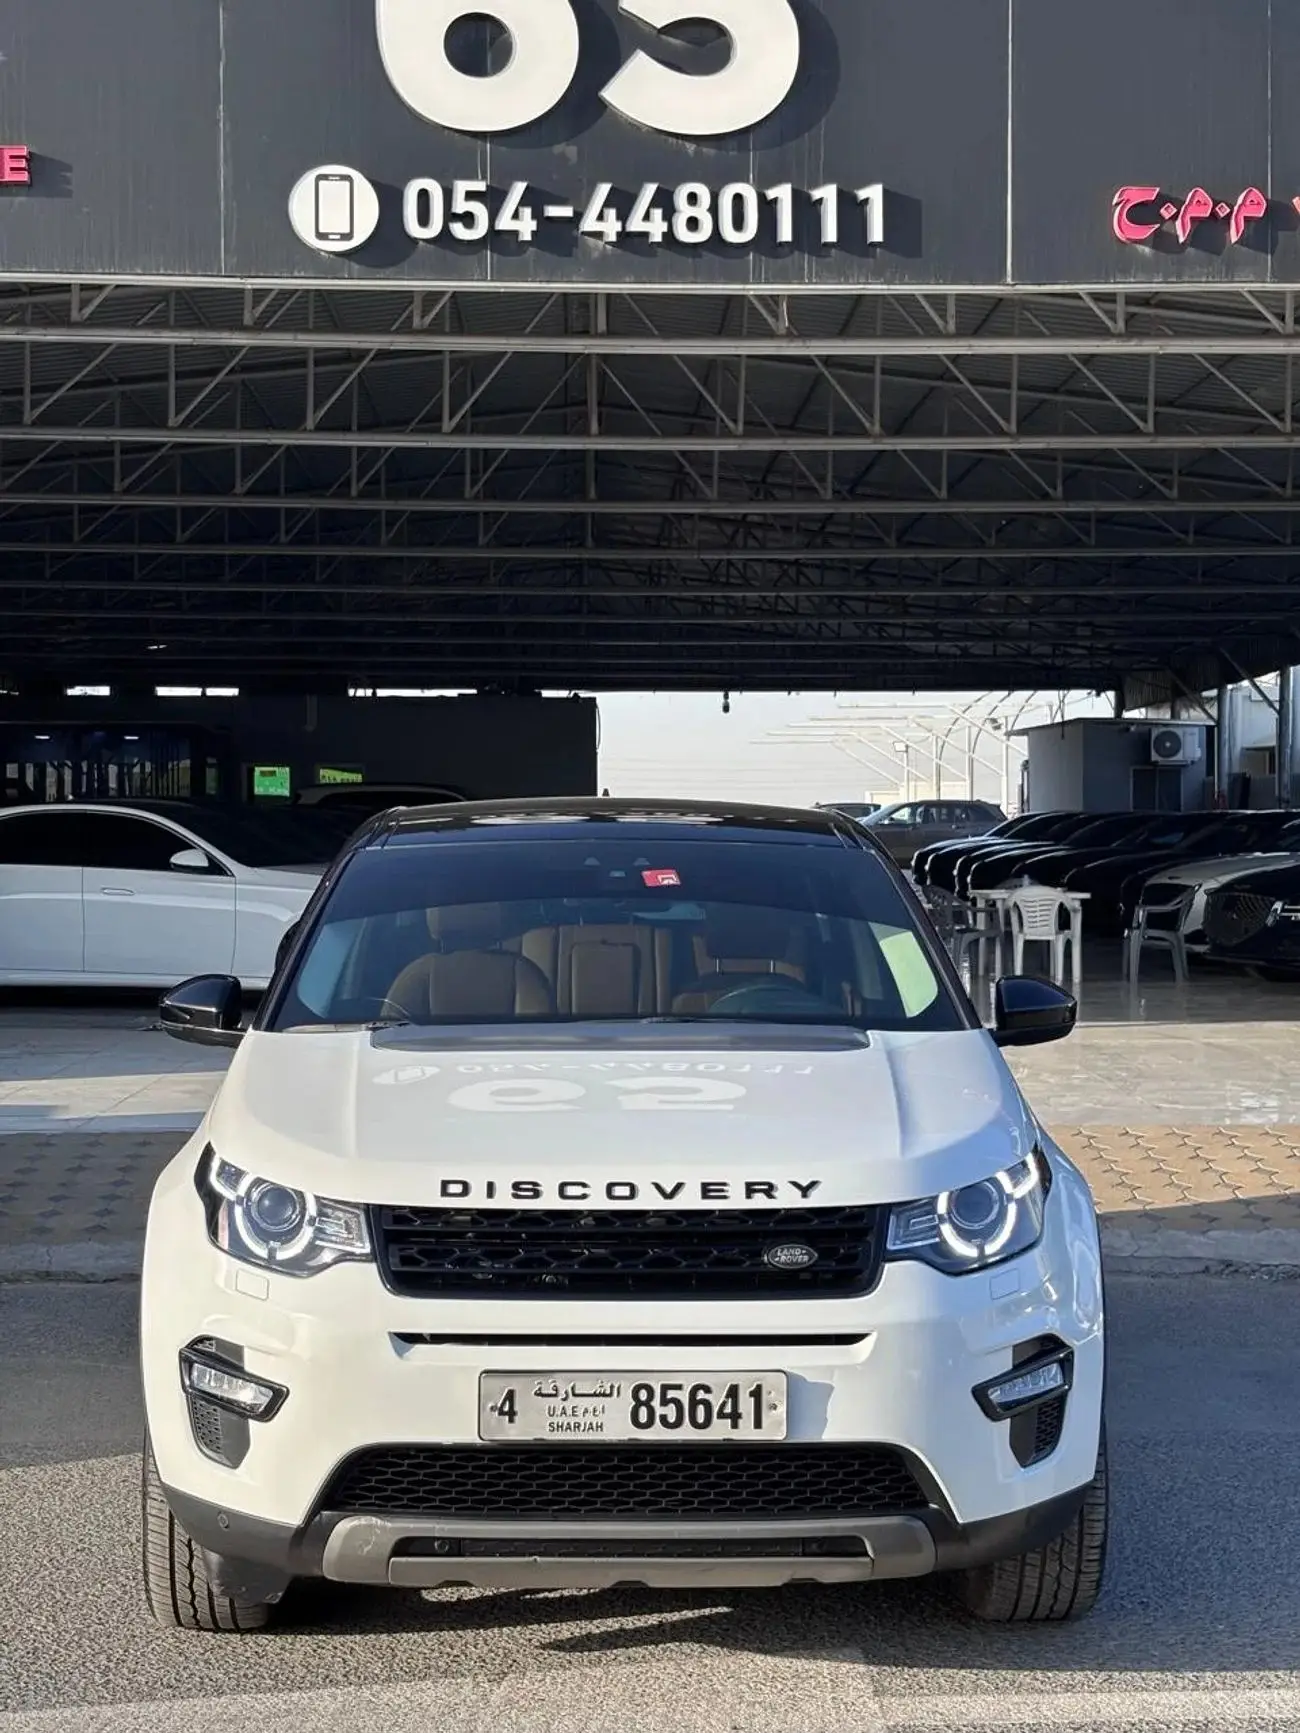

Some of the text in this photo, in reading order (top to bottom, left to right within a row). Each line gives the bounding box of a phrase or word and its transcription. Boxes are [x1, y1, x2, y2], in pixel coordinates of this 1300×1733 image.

[402, 178, 887, 245] 054-4480111
[439, 1178, 822, 1201] DISCOVERY
[498, 1387, 518, 1424] 4
[533, 1379, 622, 1402] الشارقة
[630, 1382, 765, 1431] 85641
[548, 1421, 604, 1433] SHARJAH
